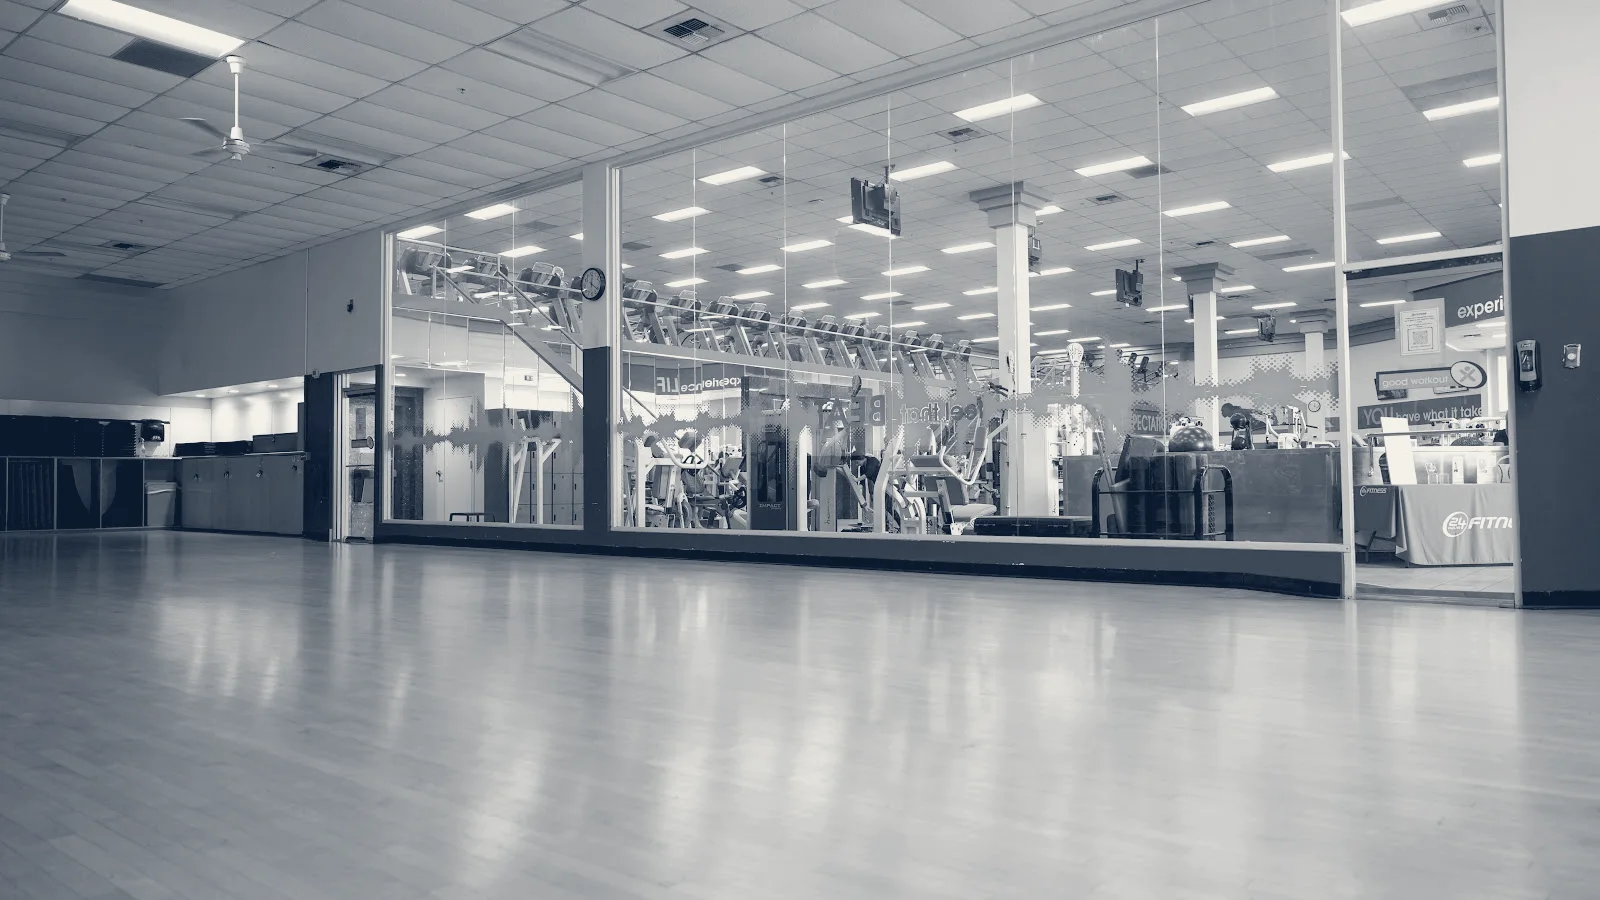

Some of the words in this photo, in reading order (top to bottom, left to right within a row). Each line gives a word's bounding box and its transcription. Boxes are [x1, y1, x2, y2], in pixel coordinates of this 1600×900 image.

[1457, 295, 1504, 319] experi
[1382, 378, 1409, 389] good
[1411, 376, 1449, 385] workout
[1363, 406, 1394, 426] YOU
[1423, 407, 1449, 421] what
[1451, 406, 1458, 420] it
[1448, 516, 1467, 530] 24
